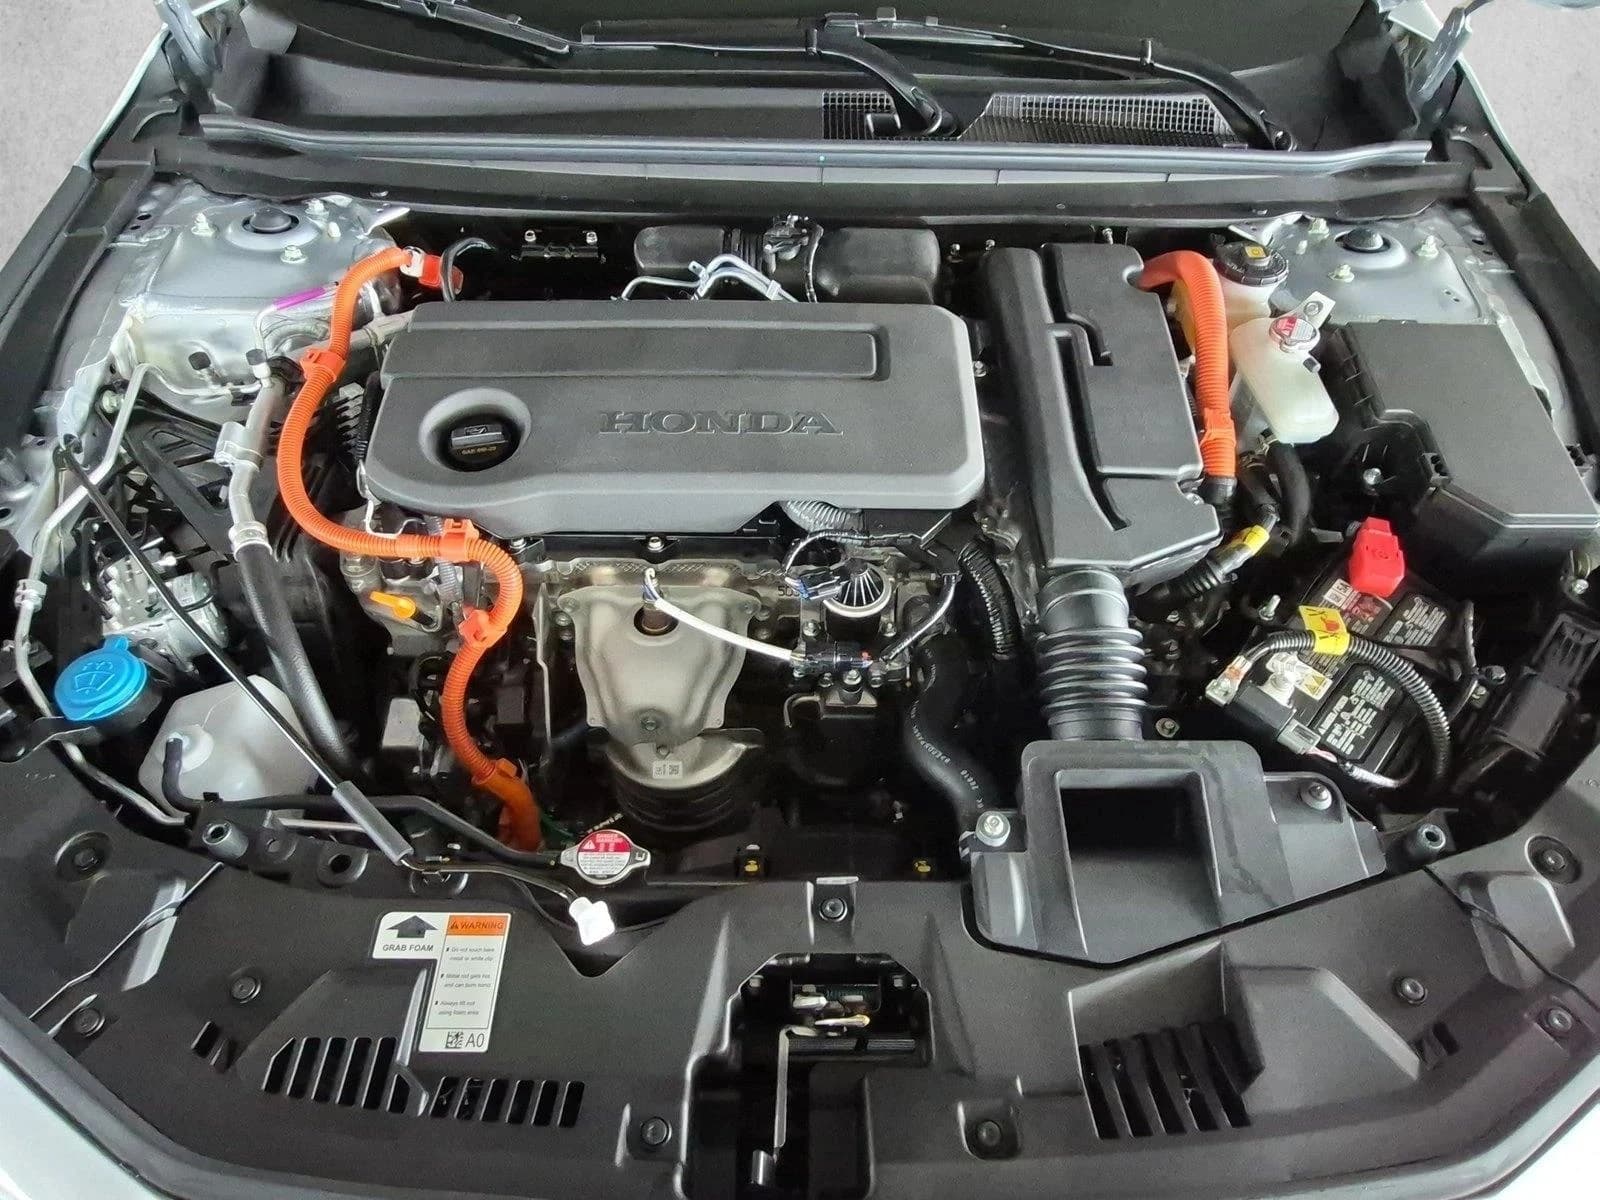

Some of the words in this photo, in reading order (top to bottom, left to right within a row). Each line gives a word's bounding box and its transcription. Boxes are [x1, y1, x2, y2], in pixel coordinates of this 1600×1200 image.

[599, 411, 844, 436] HONDA
[461, 920, 503, 929] WARNING
[382, 944, 407, 952] GRAB
[409, 944, 434, 952] FOAM
